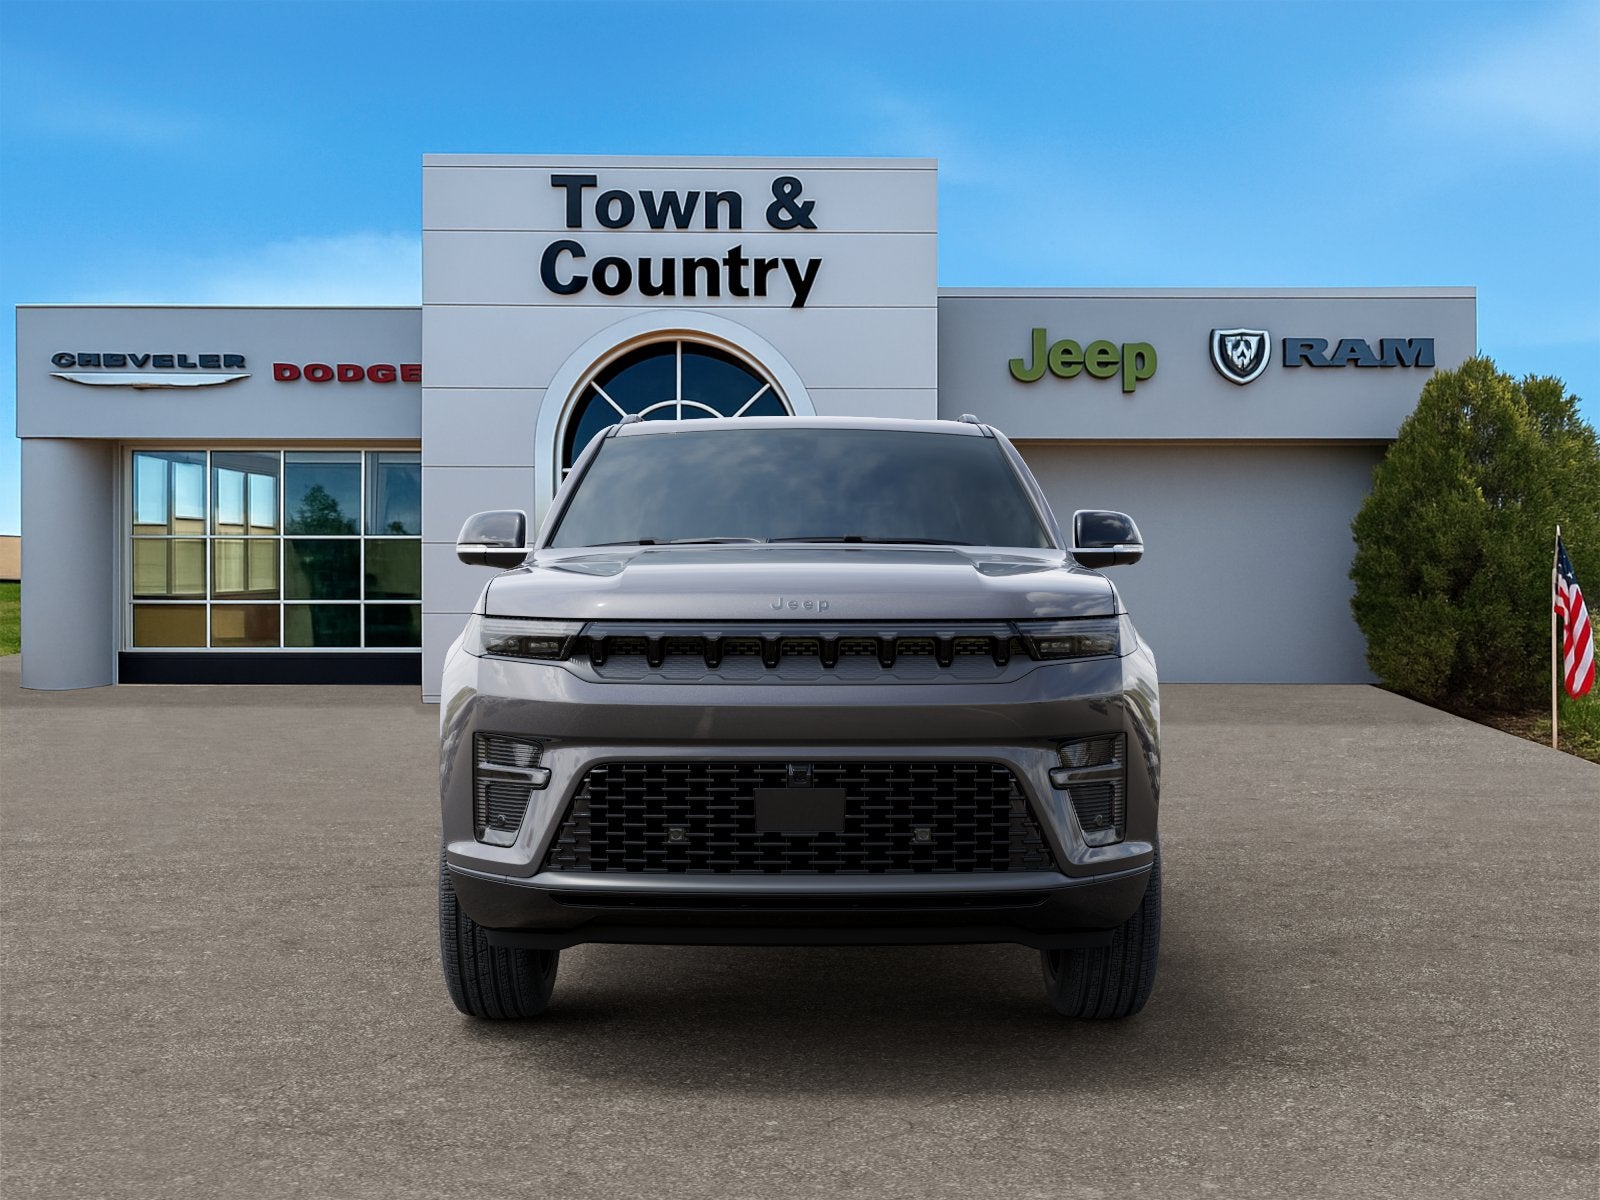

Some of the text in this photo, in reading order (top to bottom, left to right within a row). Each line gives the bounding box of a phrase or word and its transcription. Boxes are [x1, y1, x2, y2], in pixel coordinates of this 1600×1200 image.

[550, 174, 818, 230] Town &
[540, 239, 822, 308] Country
[273, 363, 422, 382] DODGE
[1008, 328, 1158, 393] Jeep
[1282, 337, 1435, 368] RAM
[769, 597, 830, 613] Jeep
